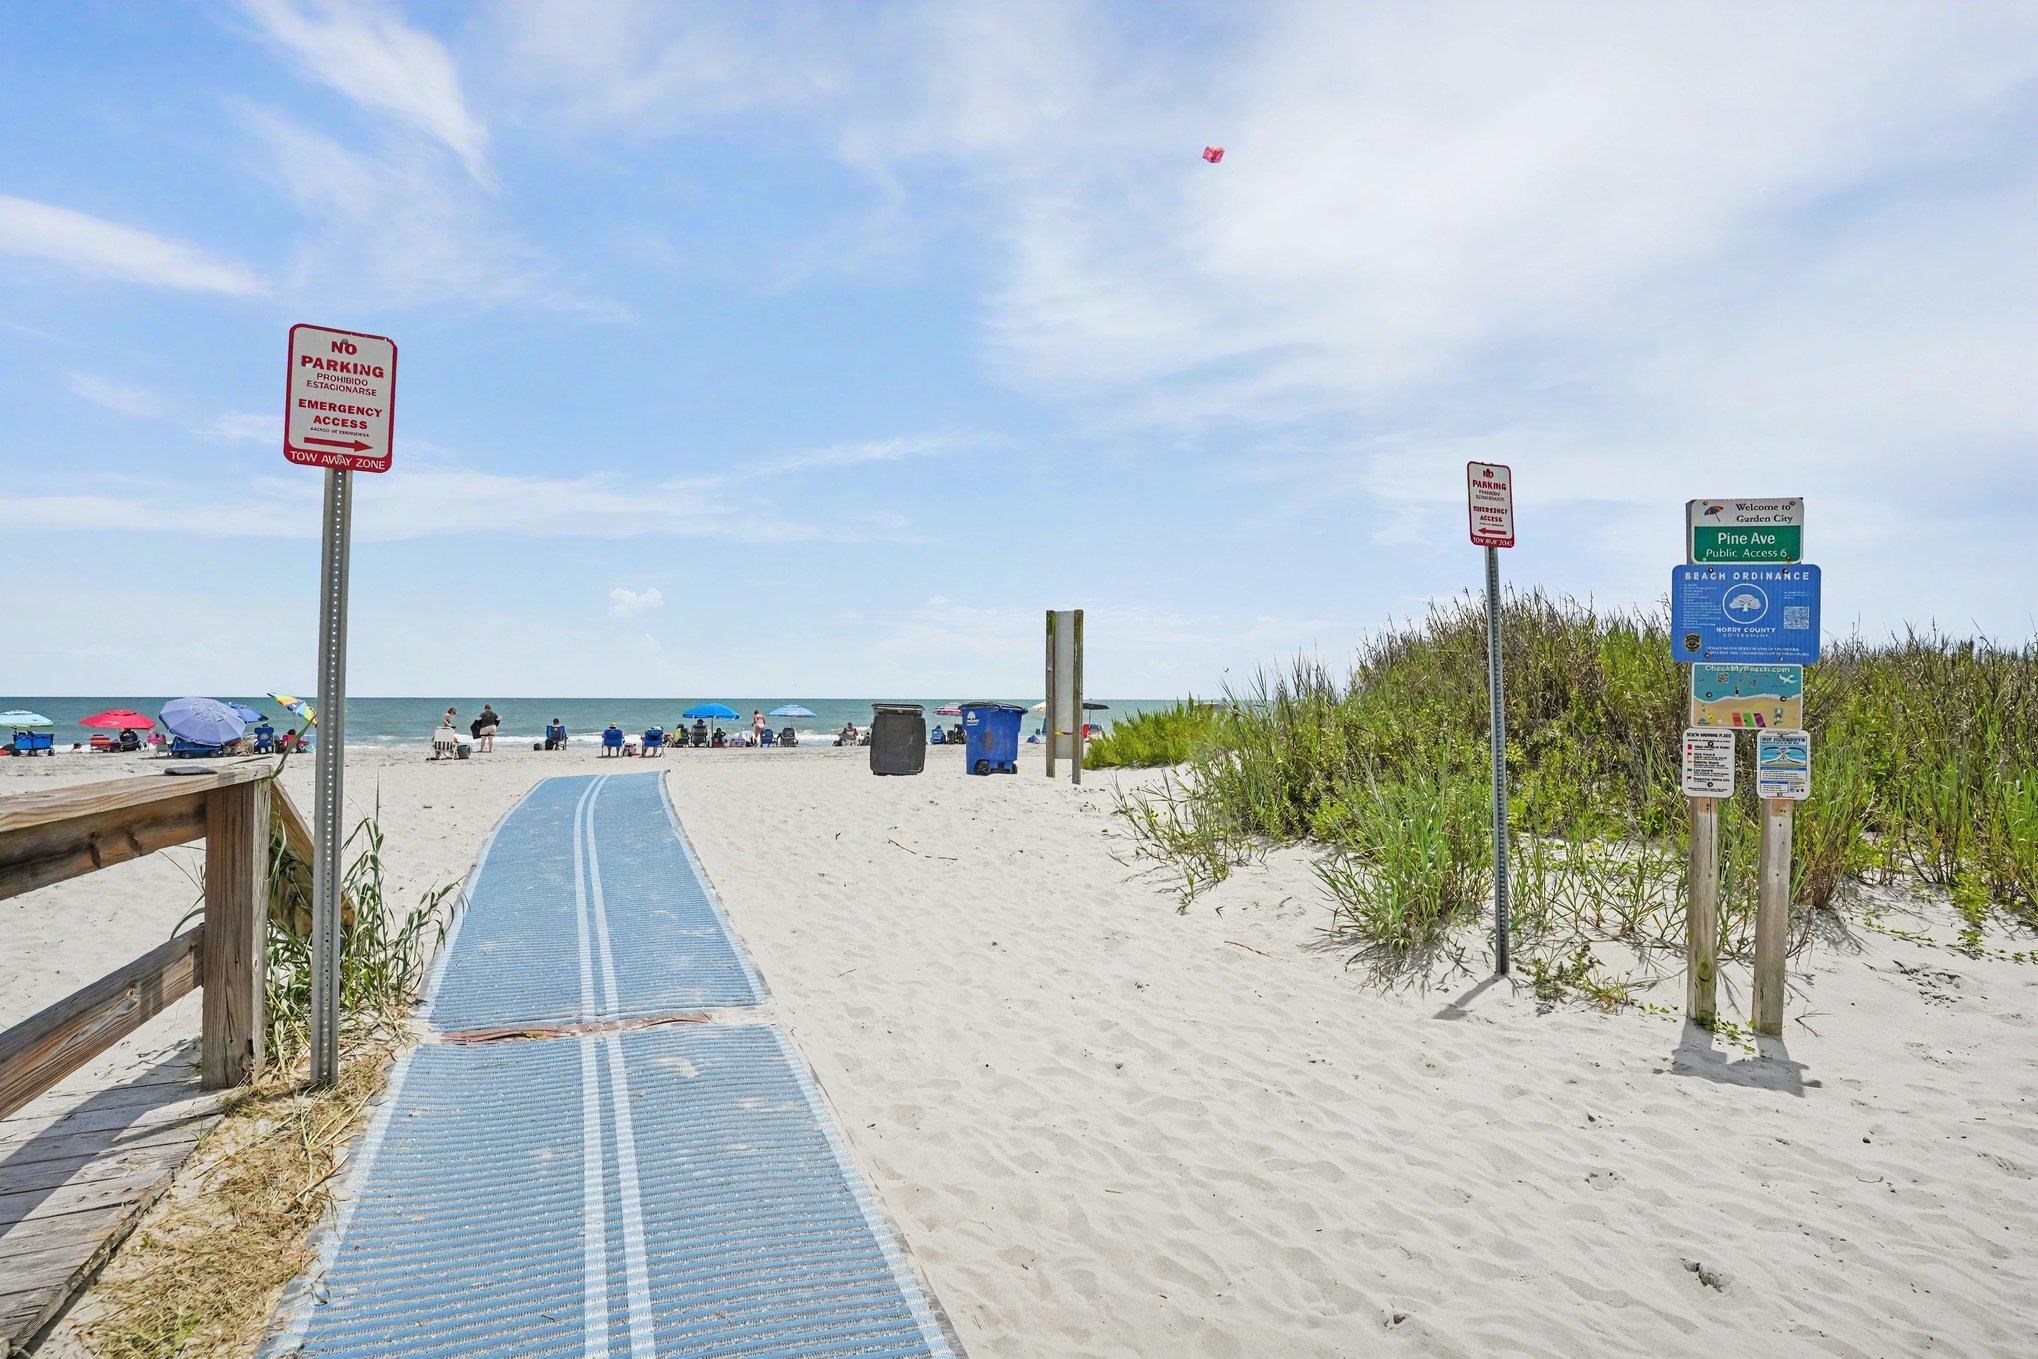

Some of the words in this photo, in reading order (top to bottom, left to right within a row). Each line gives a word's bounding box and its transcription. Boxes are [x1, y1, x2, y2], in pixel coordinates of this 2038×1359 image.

[331, 341, 357, 356] NO
[300, 355, 384, 378] PARKING
[316, 372, 368, 386] PROHIBIDO
[306, 380, 376, 396] ESTACIONARSE
[298, 398, 382, 418] EMERGENCY
[313, 415, 368, 430] ACCESS
[290, 450, 318, 462] TOW
[321, 454, 352, 466] AWAY
[356, 458, 386, 470] ZONE
[1472, 480, 1506, 490] PARKING
[1736, 515, 1770, 523] Garden
[1773, 514, 1794, 524] City
[1718, 532, 1748, 544] Pine
[1750, 532, 1776, 544] Ave
[1706, 548, 1738, 558] Public
[1743, 549, 1778, 558] Access
[1780, 548, 1787, 558] 6
[1685, 572, 1726, 580] BEACH
[1733, 572, 1810, 580] ORDINANCE
